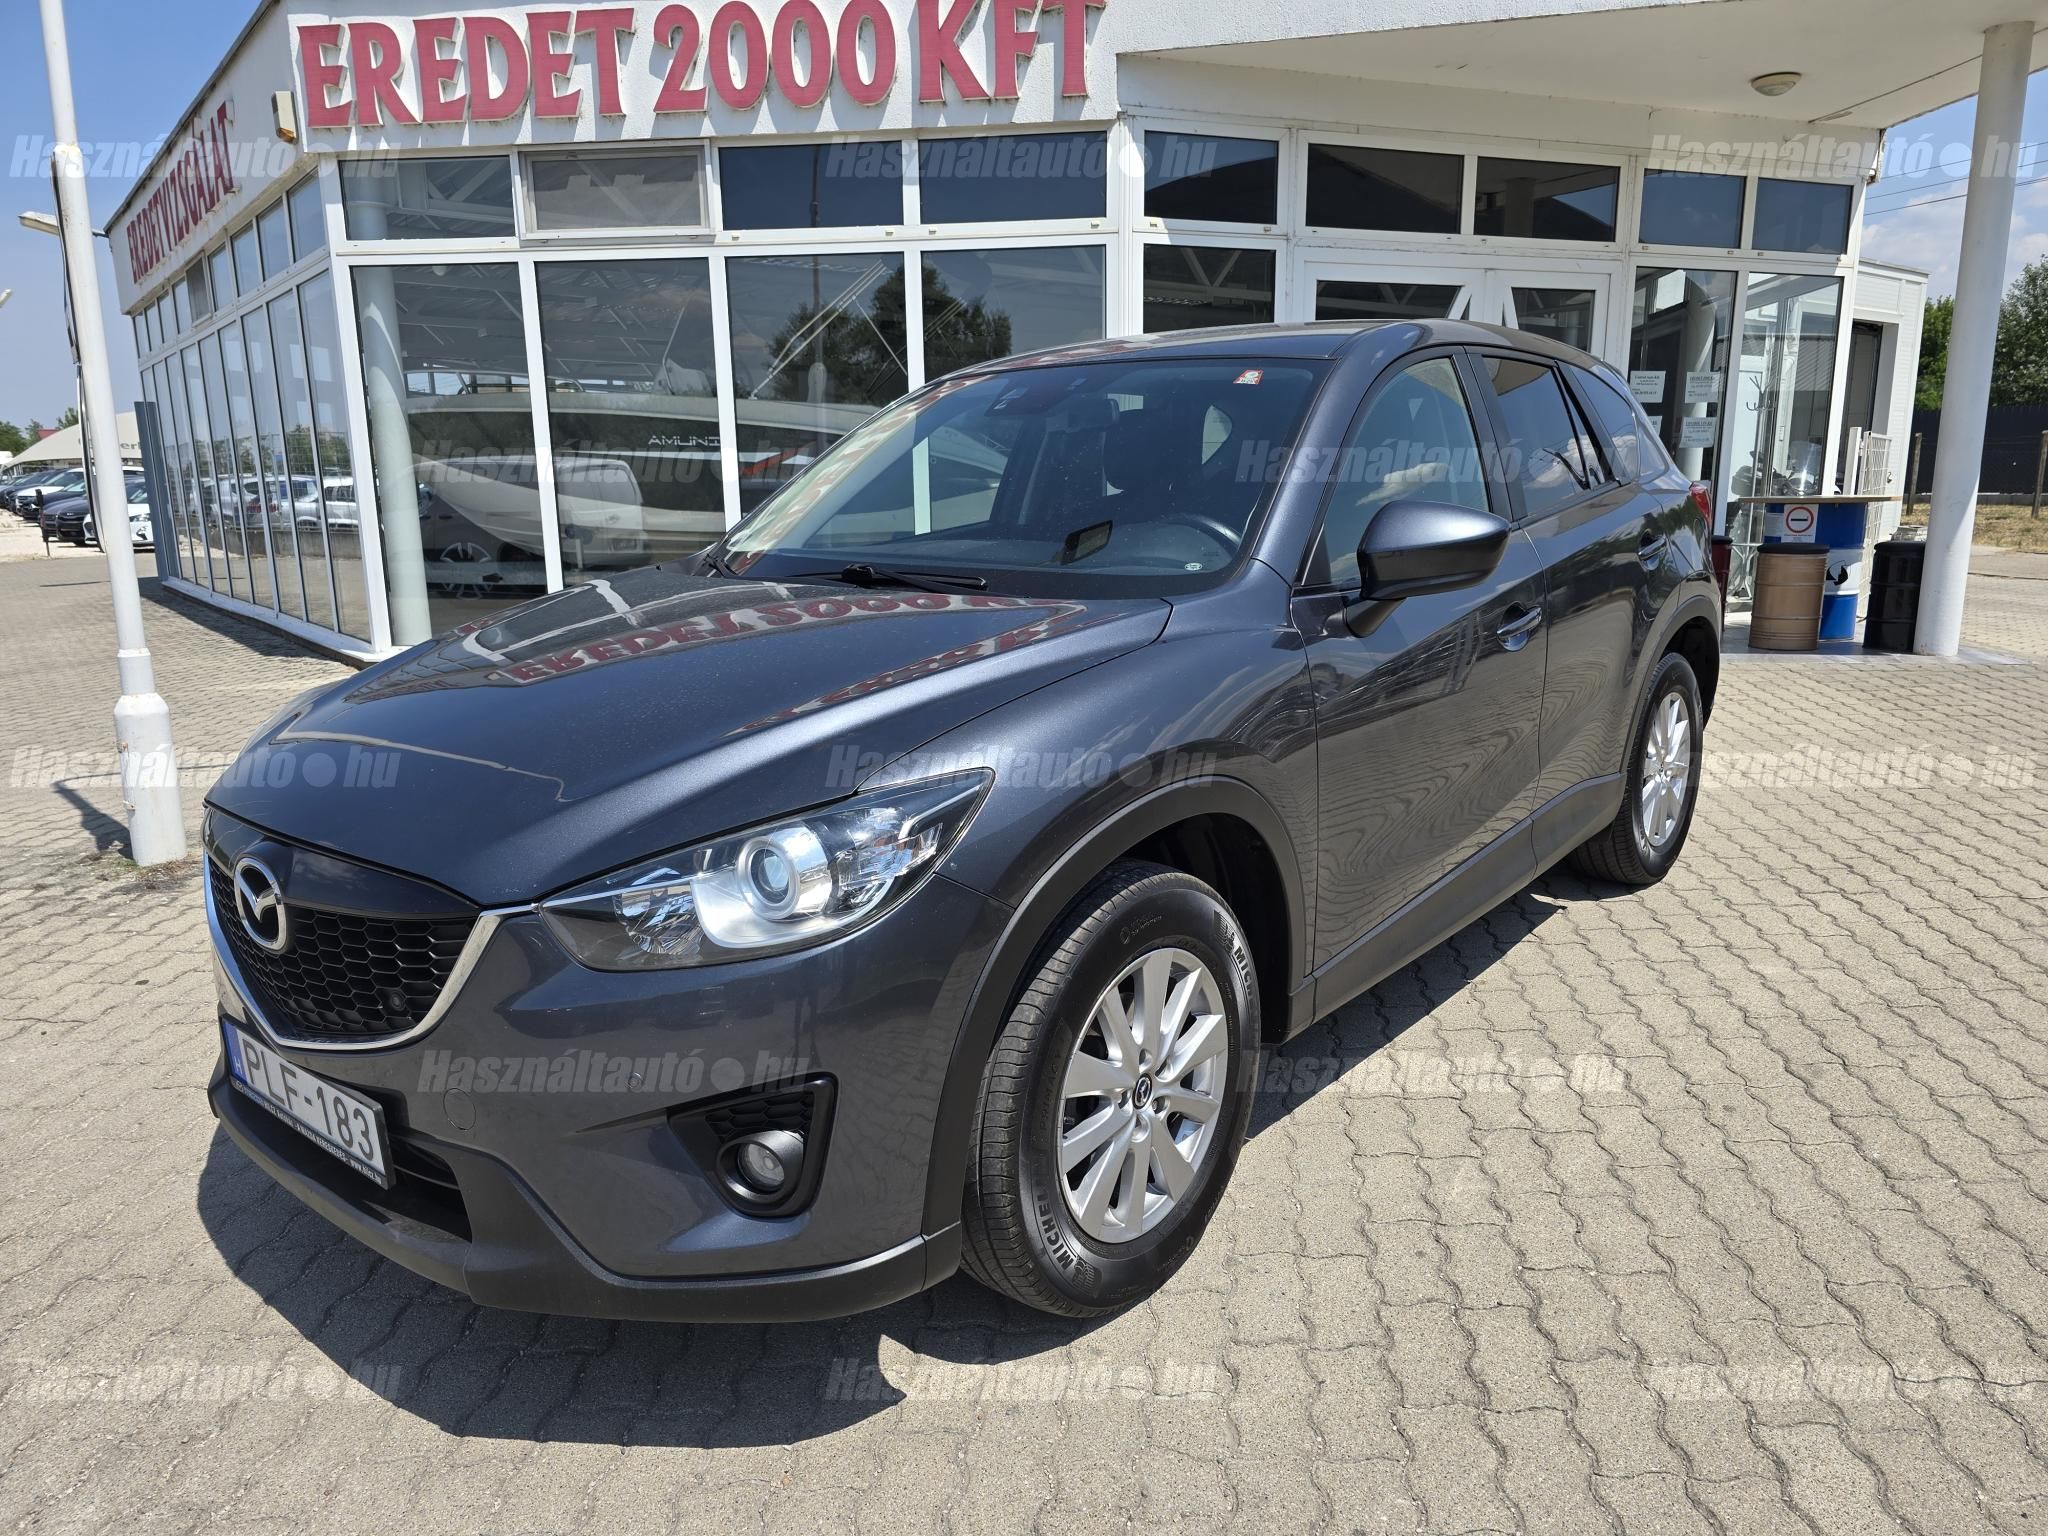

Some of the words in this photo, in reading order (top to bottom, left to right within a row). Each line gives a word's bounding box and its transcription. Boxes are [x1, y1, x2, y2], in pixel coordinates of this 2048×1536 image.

[297, 8, 636, 128] EREDET
[654, 0, 897, 113] 2000
[916, 0, 1104, 103] KFT
[127, 101, 234, 284] EREDETVIZSGÁLAT
[234, 1056, 243, 1075] H
[242, 1038, 374, 1162] PLF-183
